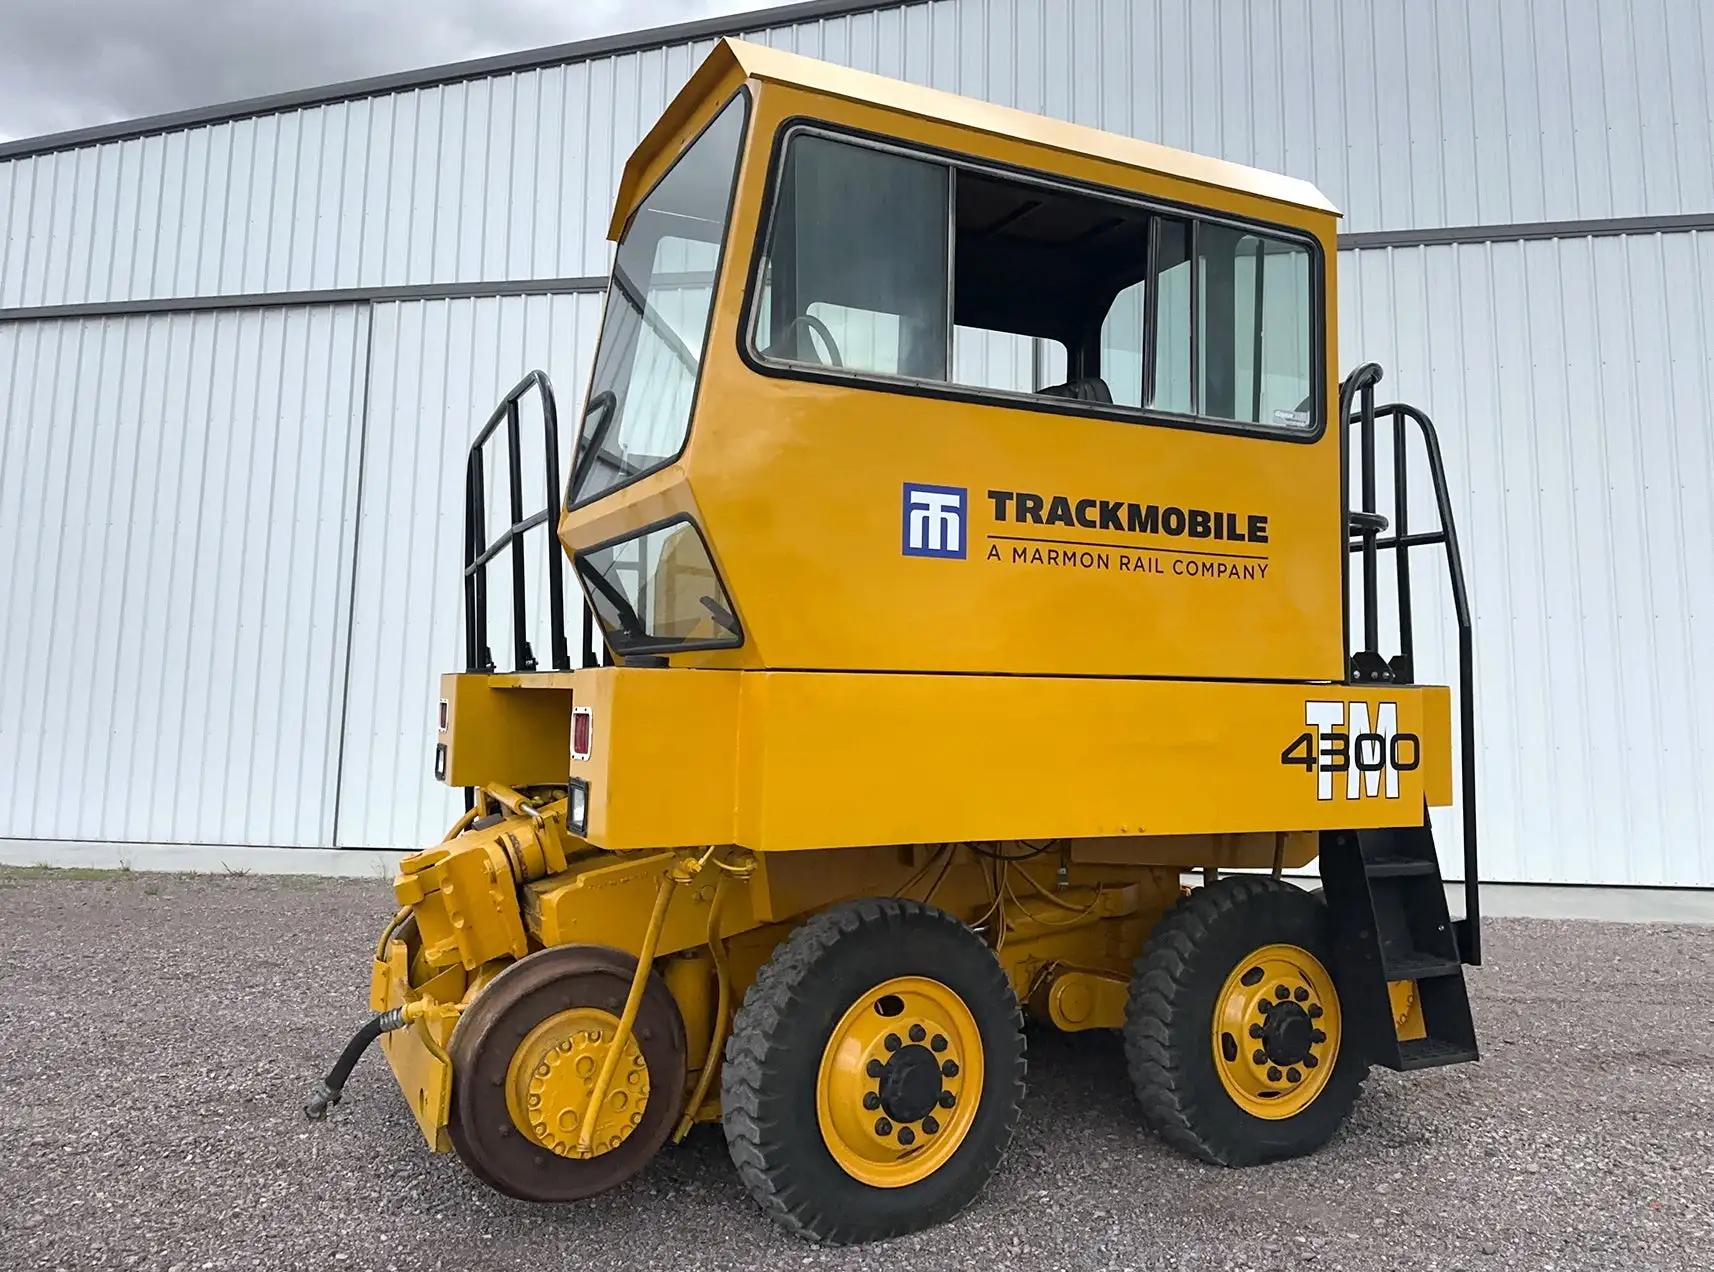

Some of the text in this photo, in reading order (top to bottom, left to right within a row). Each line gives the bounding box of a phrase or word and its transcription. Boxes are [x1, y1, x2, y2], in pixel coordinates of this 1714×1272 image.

[987, 489, 1269, 544] TRACKMOBILE
[987, 544, 1268, 580] A MARMON RAIL COMPANY
[1281, 733, 1420, 772] 4300
[1305, 700, 1399, 800] TM
